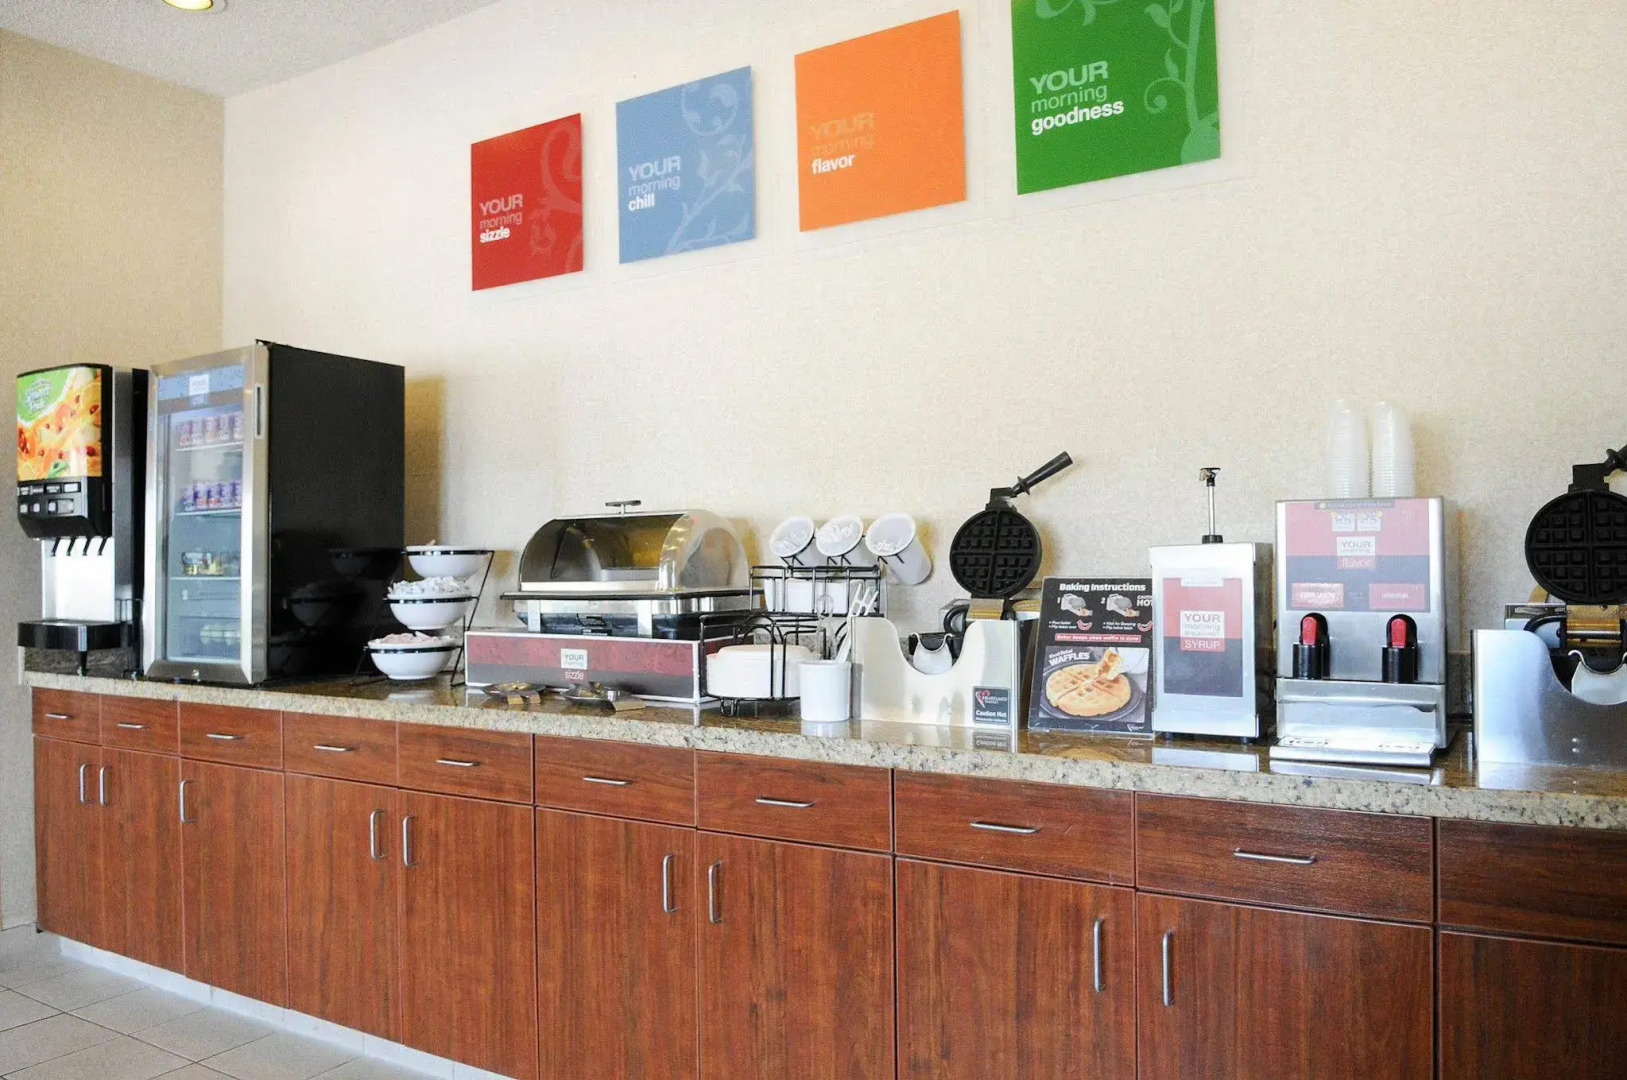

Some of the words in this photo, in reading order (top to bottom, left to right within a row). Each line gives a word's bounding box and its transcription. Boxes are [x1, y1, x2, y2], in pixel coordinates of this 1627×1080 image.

[1029, 60, 1110, 95] YOUR
[1031, 83, 1108, 113] morning
[808, 112, 875, 141] YOUR
[1031, 100, 1124, 136] goodness
[628, 155, 681, 181] YOUR
[811, 153, 856, 175] flavor
[628, 175, 681, 197] morning
[479, 194, 523, 216] YOUR
[628, 192, 655, 212] chill
[479, 211, 523, 229] morning
[479, 226, 511, 243] sizzle
[1341, 540, 1372, 548] YOUR
[1059, 582, 1091, 593] Baking
[1091, 582, 1147, 592] Instructions
[1184, 613, 1221, 622] YOUR
[1184, 639, 1221, 649] SYRUP
[1048, 651, 1090, 666] WAFFLES
[975, 709, 997, 717] Caution
